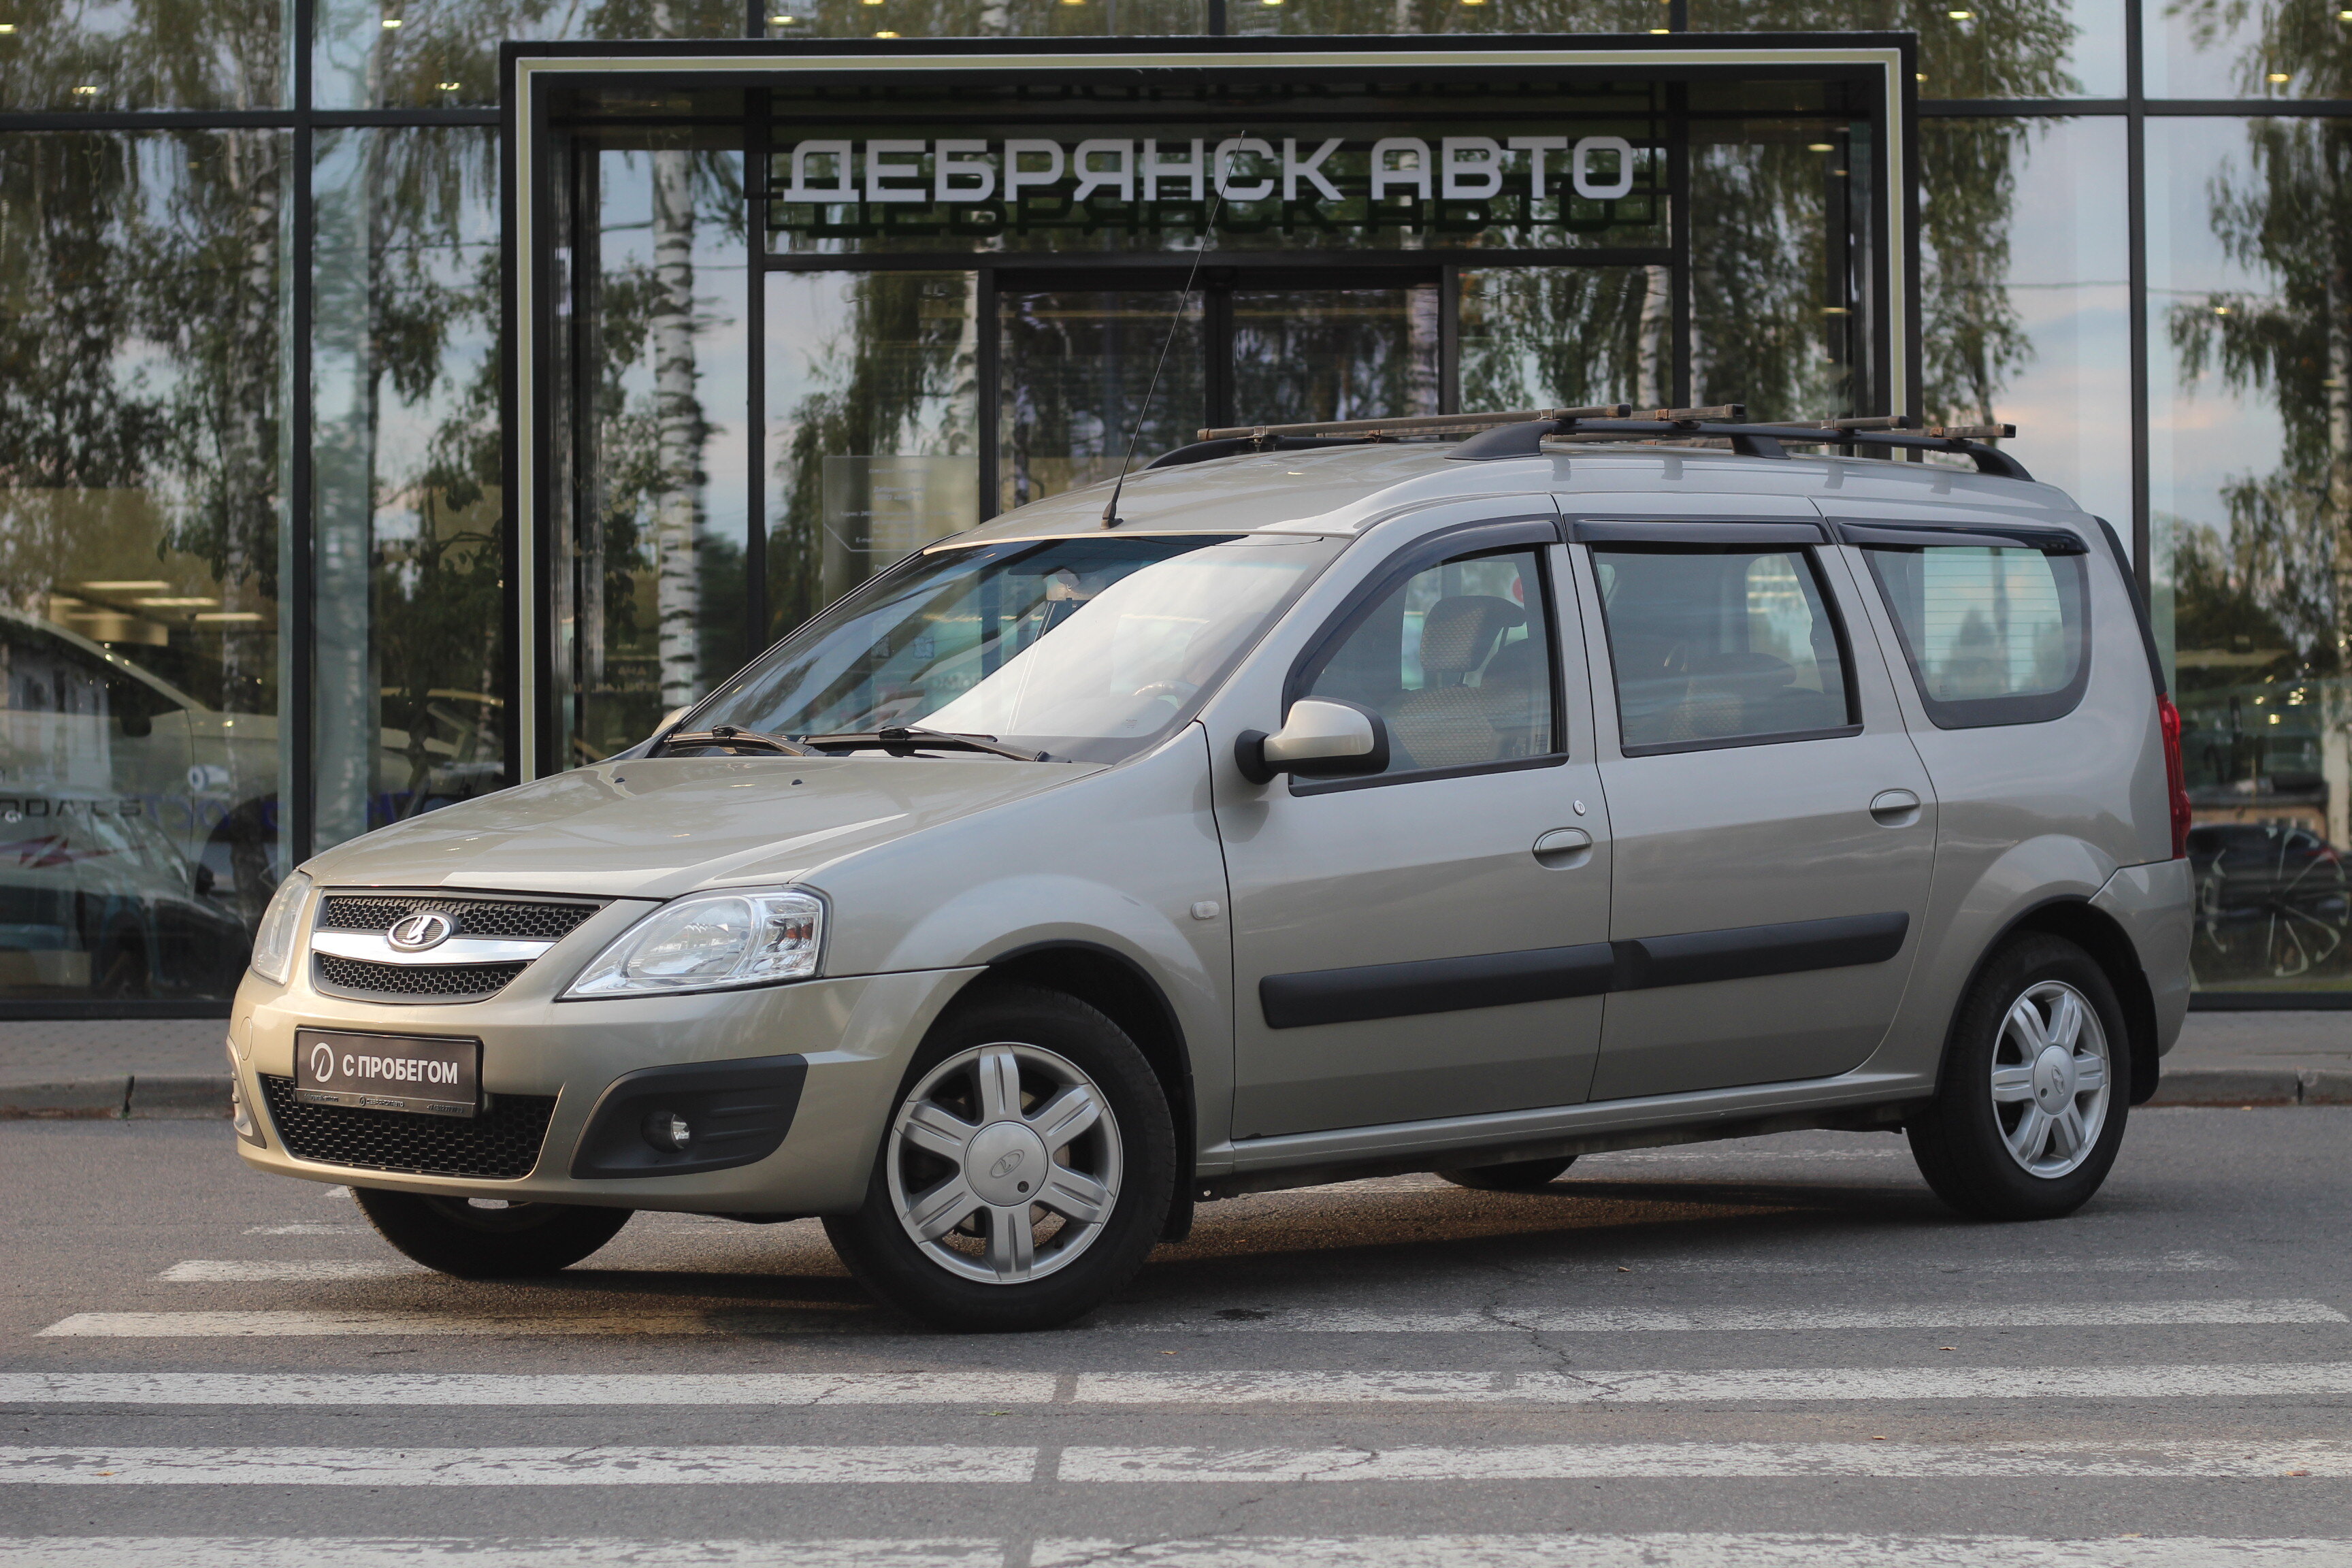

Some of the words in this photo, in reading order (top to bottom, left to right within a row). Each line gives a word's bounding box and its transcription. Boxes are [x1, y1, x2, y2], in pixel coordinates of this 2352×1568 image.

[783, 138, 1345, 202] ДЕБРЯНСК
[1371, 136, 1633, 200] АВТО
[342, 1054, 355, 1077] С
[358, 1056, 458, 1085] ПРОБЕГОМ
